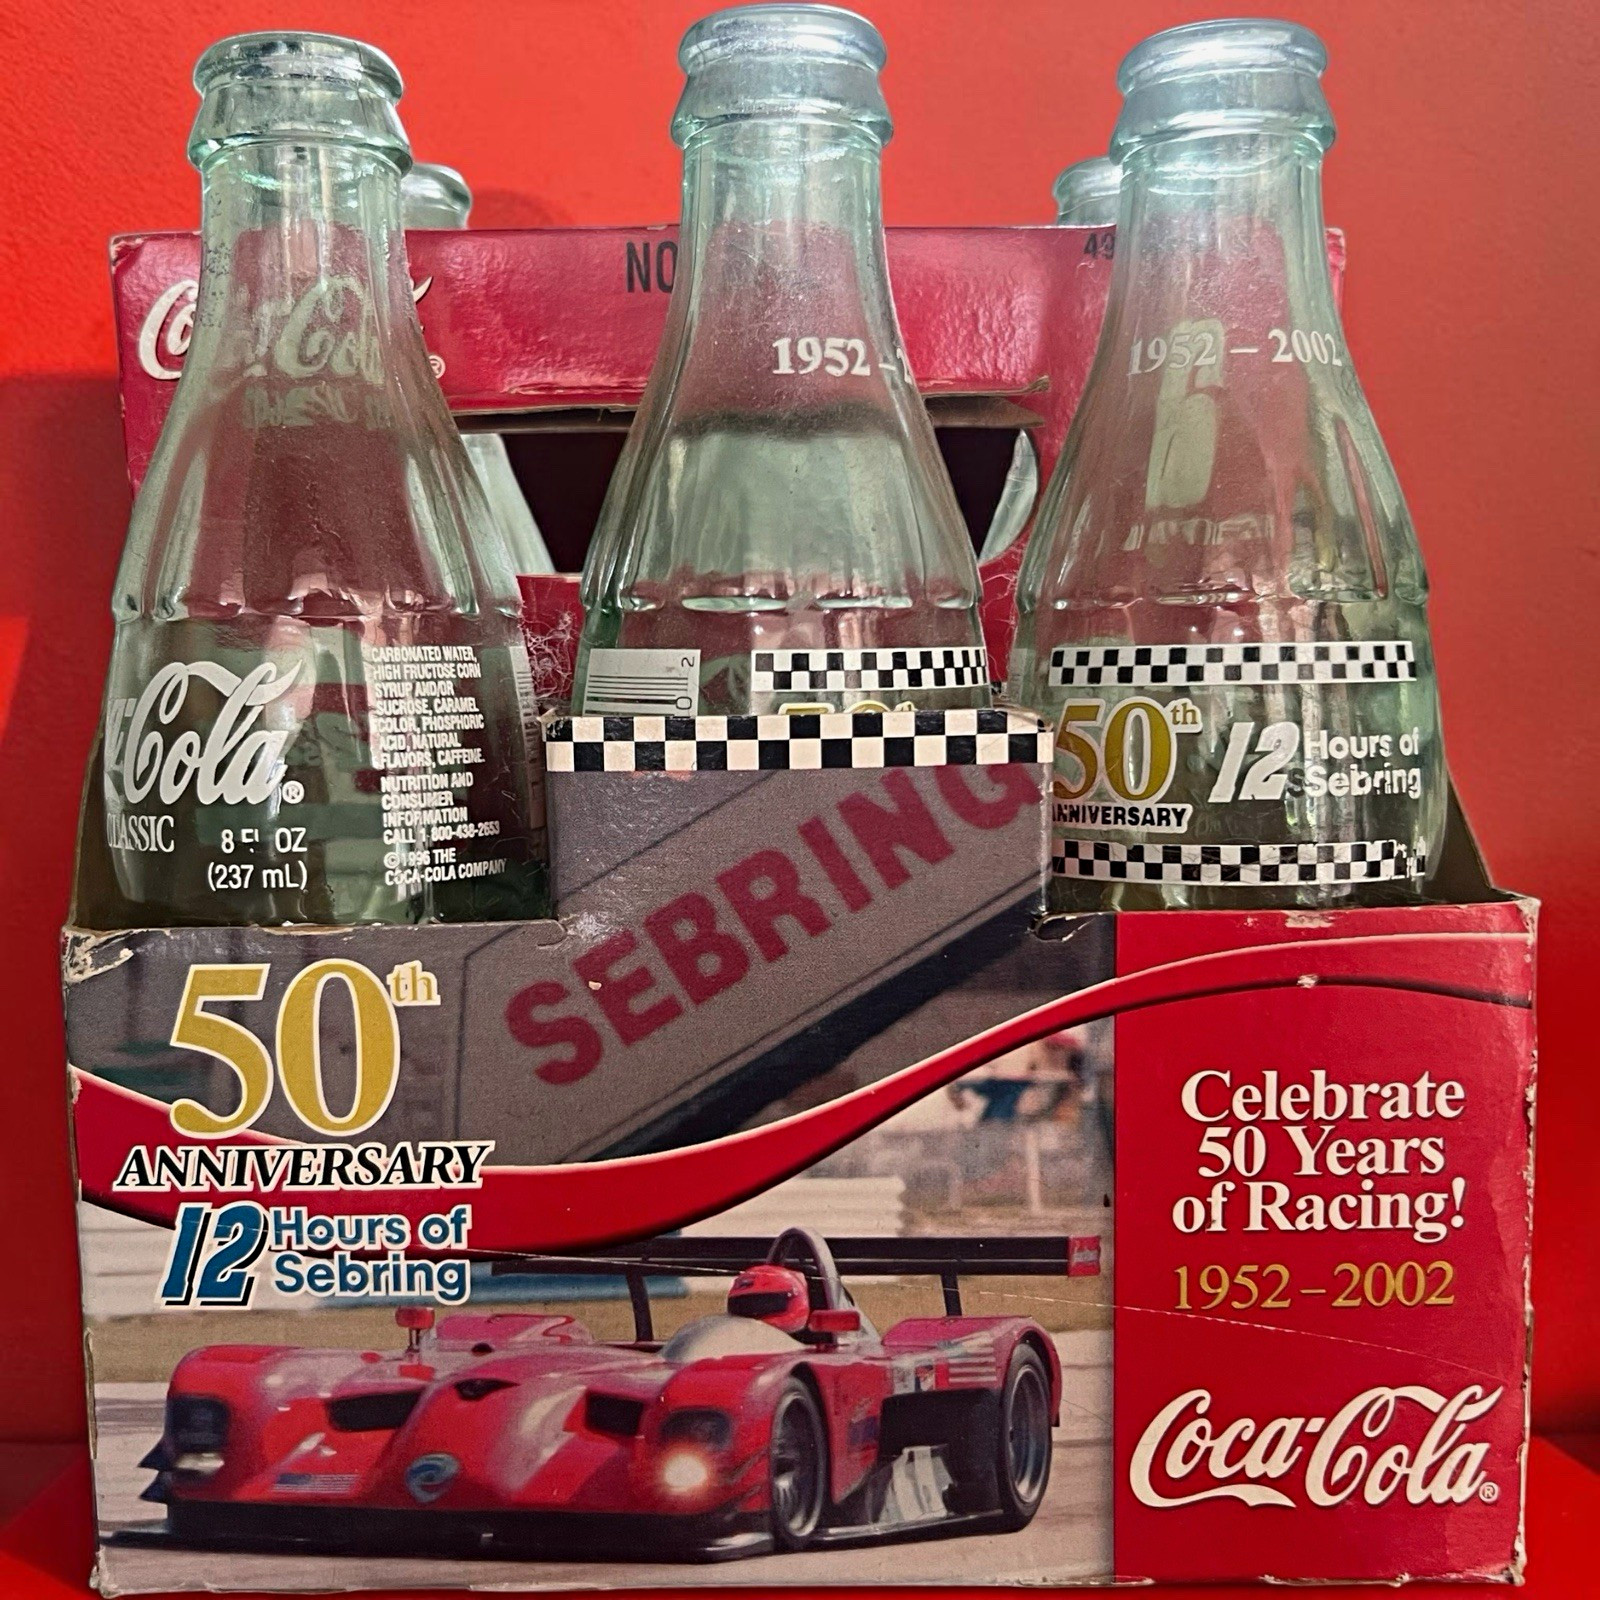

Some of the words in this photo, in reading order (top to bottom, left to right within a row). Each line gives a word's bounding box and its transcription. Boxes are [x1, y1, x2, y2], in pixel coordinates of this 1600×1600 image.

[772, 337, 871, 377] 1952
[1127, 332, 1216, 376] 1952
[1268, 328, 1343, 367] 2002
[371, 646, 441, 662] CARBONATED
[442, 646, 477, 662] WATER,
[374, 664, 401, 680] HIGH
[403, 663, 456, 680] FRUCTOSE
[457, 663, 481, 678] CORN
[375, 682, 413, 698] SYRUP
[415, 680, 454, 697] AND/OR
[376, 698, 433, 716] SUCROSE,
[433, 697, 479, 713] CARAMEL
[380, 716, 420, 733] COLOR,
[421, 714, 484, 731] PHOSPHORIC
[381, 734, 410, 752] ACID,
[412, 732, 461, 750] NATURAL
[381, 751, 436, 769] FLAVORS,
[437, 748, 485, 765] CAFFEINE.
[1208, 721, 1300, 803] 12
[1304, 730, 1392, 759] Hours
[1399, 727, 1419, 756] of
[381, 773, 448, 792] NUTRITION
[451, 771, 473, 787] AND
[1304, 762, 1420, 799] Sebring
[381, 791, 454, 811] CONSUMER
[383, 807, 468, 827] INFORMATION
[1052, 803, 1187, 828] NNIVERSARY
[106, 814, 175, 853] CLASSIC
[221, 828, 235, 853] 8
[275, 827, 308, 853] OZ
[383, 828, 416, 845] CALL
[432, 848, 456, 864] THE
[208, 861, 254, 891] (237
[262, 860, 308, 889] mL)
[385, 865, 456, 886] COCA-COLA
[458, 858, 507, 879] COMPANY
[503, 764, 1042, 1086] SEBRING
[1181, 1070, 1465, 1122] Celebrate
[1198, 1125, 1267, 1178] 50
[1283, 1125, 1445, 1176] Years
[114, 1142, 494, 1192] ANNIVERSARY
[1172, 1182, 1235, 1233] of
[1243, 1177, 1466, 1243] Racing!
[161, 1203, 267, 1309] 12
[270, 1207, 411, 1249] Hours
[418, 1205, 472, 1248] of
[274, 1251, 470, 1304] Sebring
